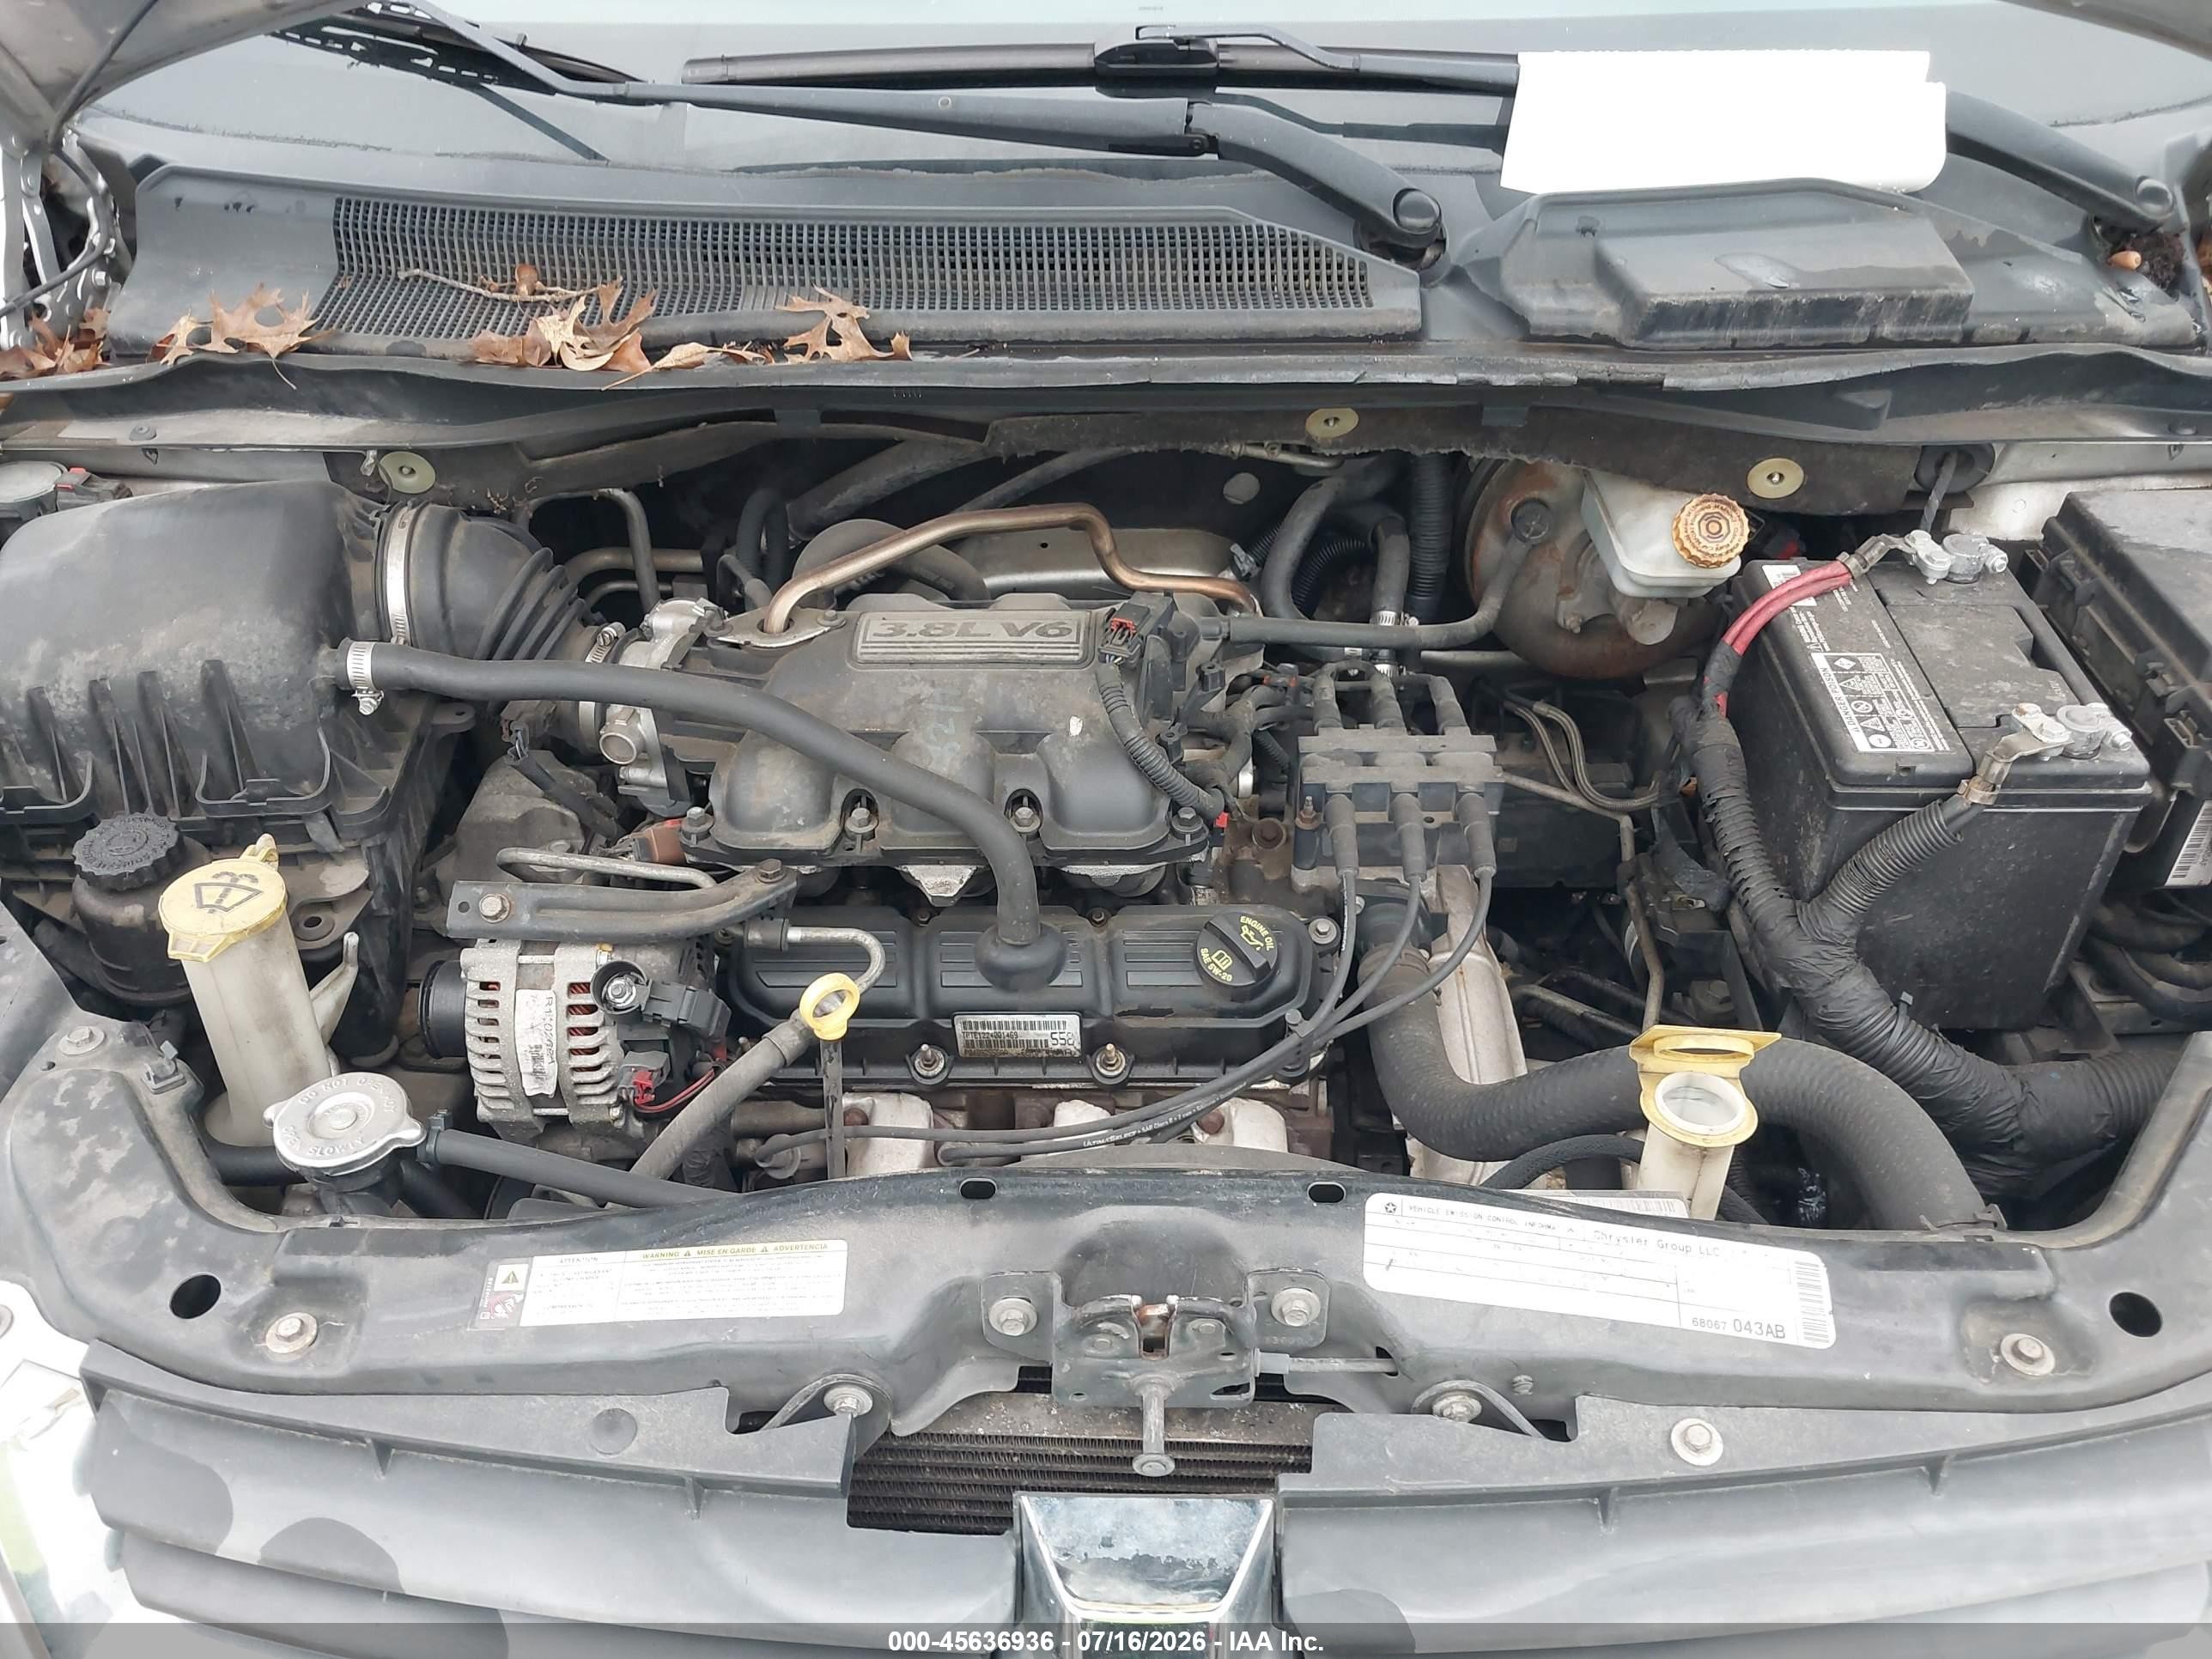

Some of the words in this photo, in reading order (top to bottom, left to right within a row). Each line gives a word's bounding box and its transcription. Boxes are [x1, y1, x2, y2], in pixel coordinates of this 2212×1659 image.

[872, 621, 991, 638] 3.8L
[1000, 621, 1073, 638] V6
[1820, 667, 1839, 694] POISON
[1834, 696, 1856, 726] DANGER
[1240, 915, 1269, 937] ENGINE
[1264, 937, 1275, 951] OIL
[1200, 947, 1212, 964] SAE
[1207, 963, 1233, 982] 5W-20
[297, 1091, 318, 1106] DO
[322, 1078, 349, 1091] NOT
[1408, 1205, 1441, 1215] VEHICLE
[642, 1251, 680, 1260] WARNING
[696, 1248, 715, 1256] MISE
[729, 1246, 757, 1255] GARDE
[773, 1243, 829, 1252] ADVERTENCIA
[1593, 1230, 1648, 1245] Chrysler
[1656, 1239, 1692, 1254] Group
[1699, 1245, 1720, 1257] LLC
[1692, 1316, 1728, 1331] 68067
[1733, 1319, 1786, 1339] 043AB
